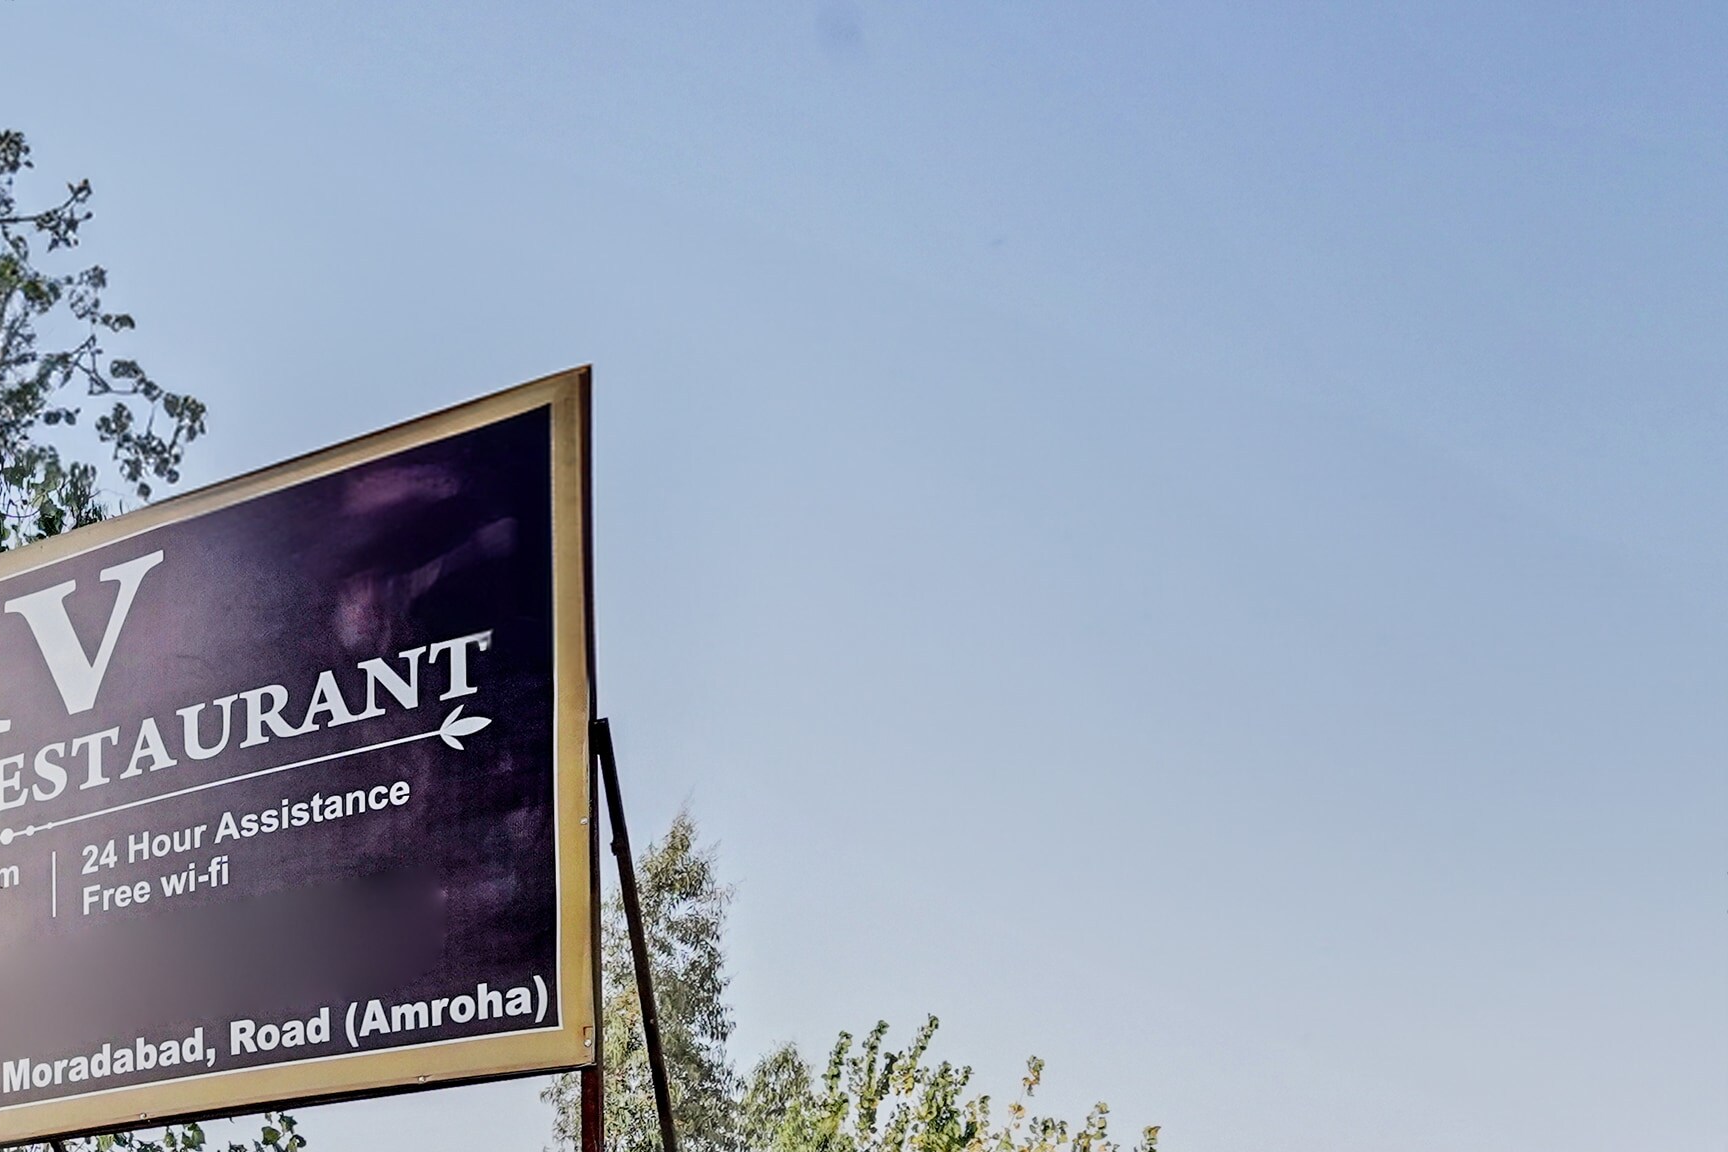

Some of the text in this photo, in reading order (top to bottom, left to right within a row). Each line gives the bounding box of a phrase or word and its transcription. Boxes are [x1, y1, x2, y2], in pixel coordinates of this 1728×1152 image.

[81, 780, 411, 875] 24 Hour Assistance
[83, 856, 229, 916] Free wi-fi
[2, 1026, 216, 1093] Moradabad,
[230, 1006, 330, 1055] Road
[345, 974, 547, 1048] (Amroha)
